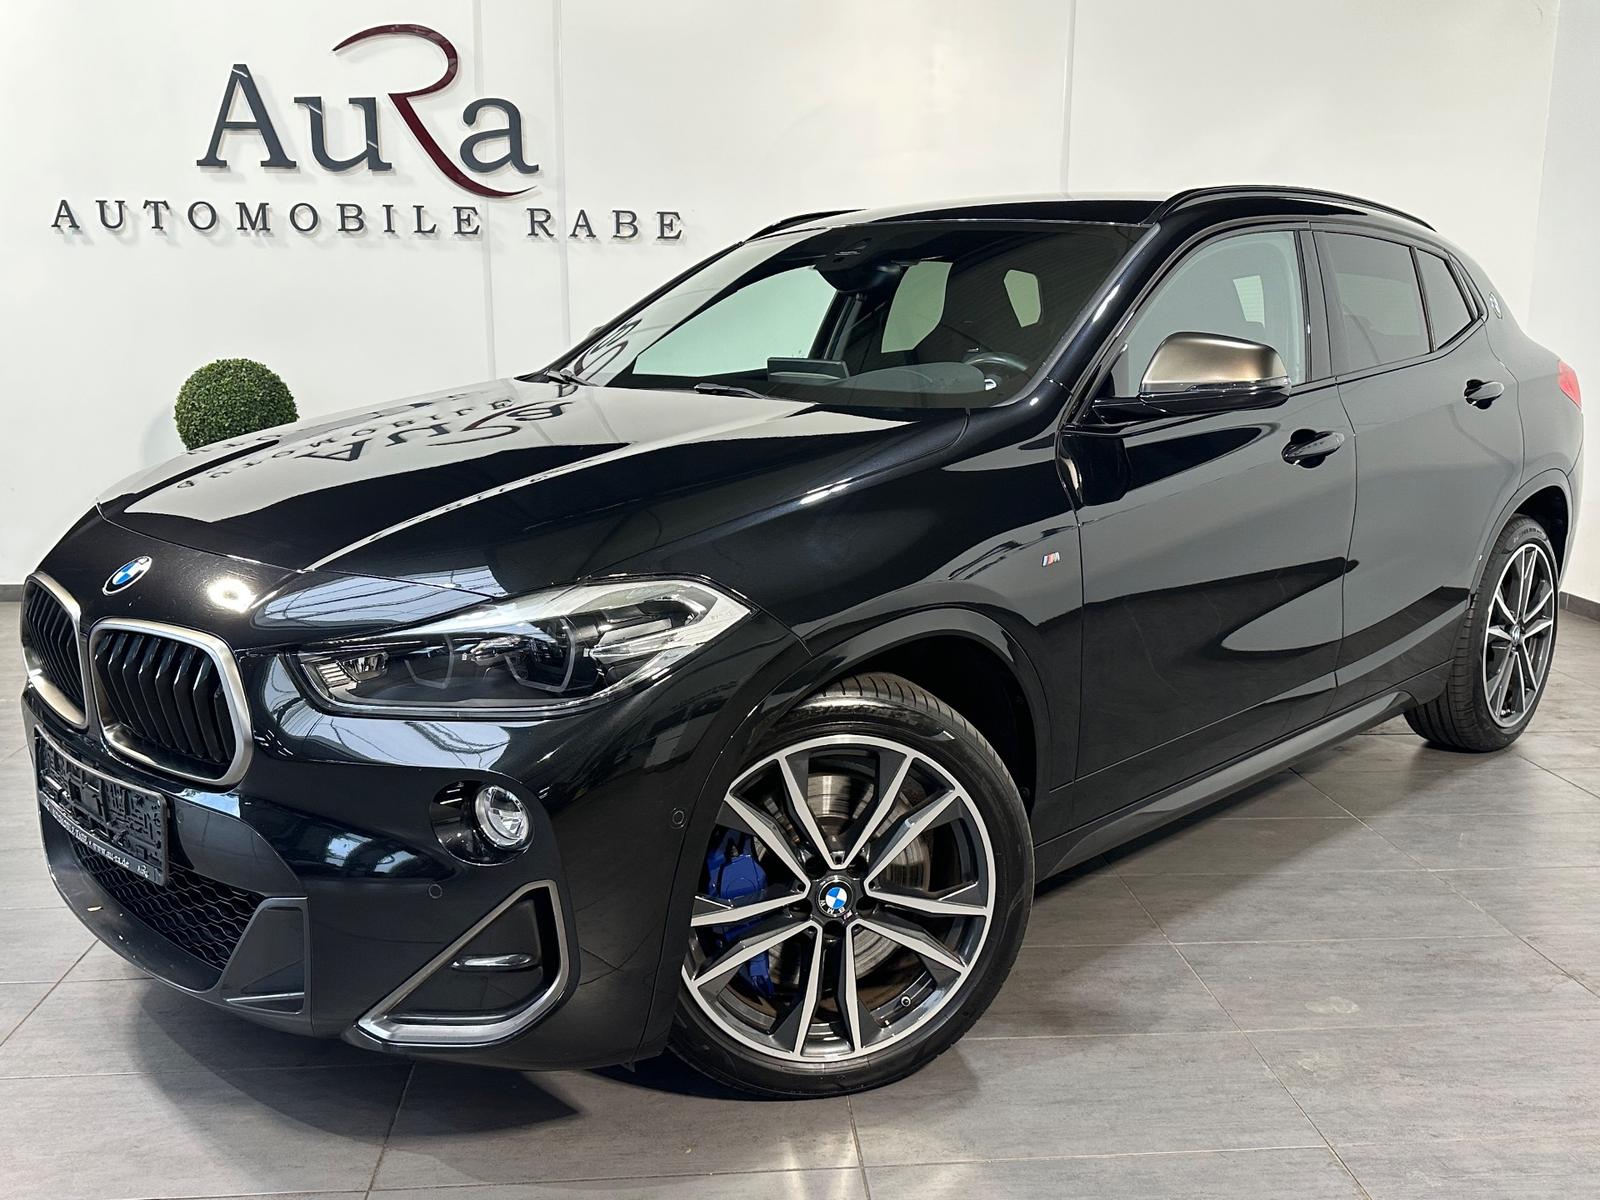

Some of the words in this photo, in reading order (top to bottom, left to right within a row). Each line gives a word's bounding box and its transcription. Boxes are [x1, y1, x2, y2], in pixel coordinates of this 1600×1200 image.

[197, 23, 539, 198] AuRa
[51, 200, 482, 236] AUTOMOBILE
[528, 207, 683, 241] RABE
